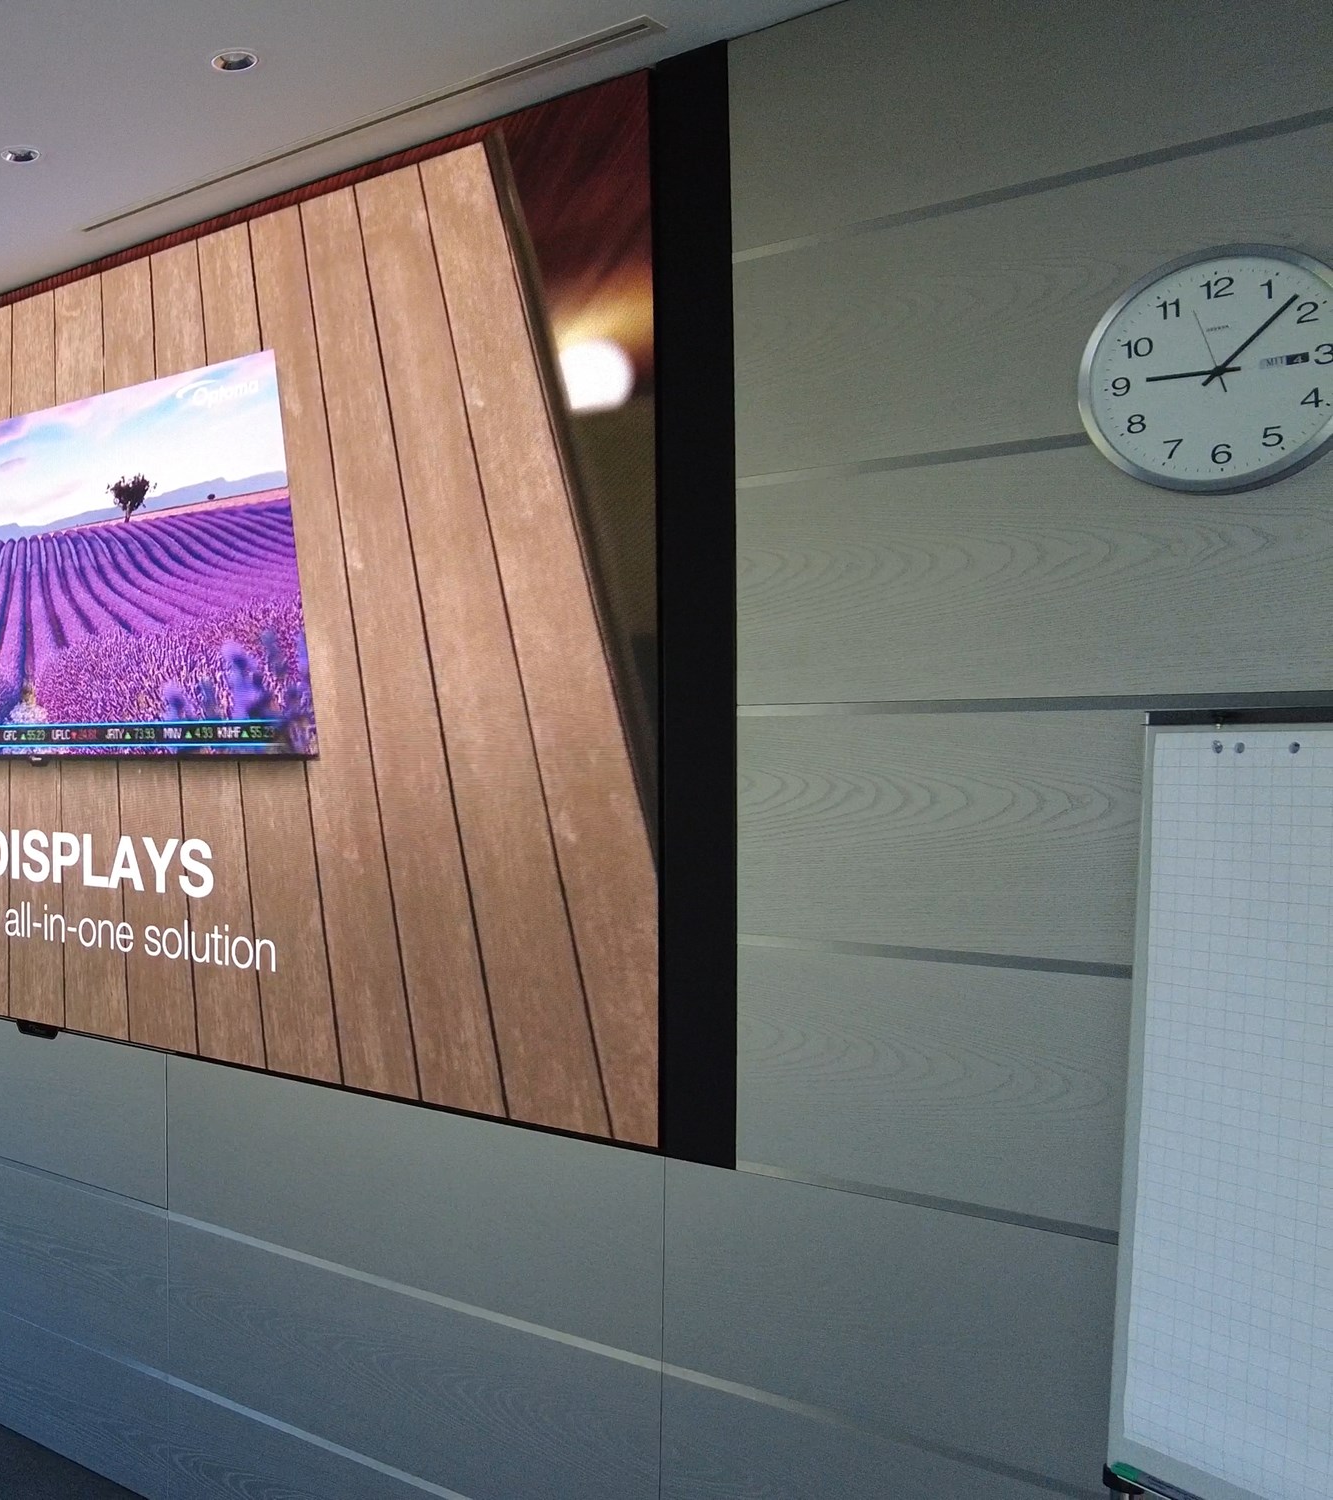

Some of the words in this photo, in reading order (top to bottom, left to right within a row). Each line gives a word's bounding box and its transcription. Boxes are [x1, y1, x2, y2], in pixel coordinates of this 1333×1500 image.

[1199, 276, 1235, 300] 12
[1259, 279, 1273, 299] 1
[1156, 298, 1181, 320] 11
[1296, 301, 1320, 324] 2
[1121, 336, 1154, 359] 10
[1314, 342, 1333, 365] 3
[1111, 377, 1131, 397] 9
[1300, 386, 1324, 408] 4
[1126, 414, 1147, 434] 8
[1261, 425, 1284, 447] 5
[1163, 438, 1184, 459] 7
[1211, 443, 1233, 465] 6
[4, 902, 134, 953] all-in-one
[144, 919, 277, 972] solution
